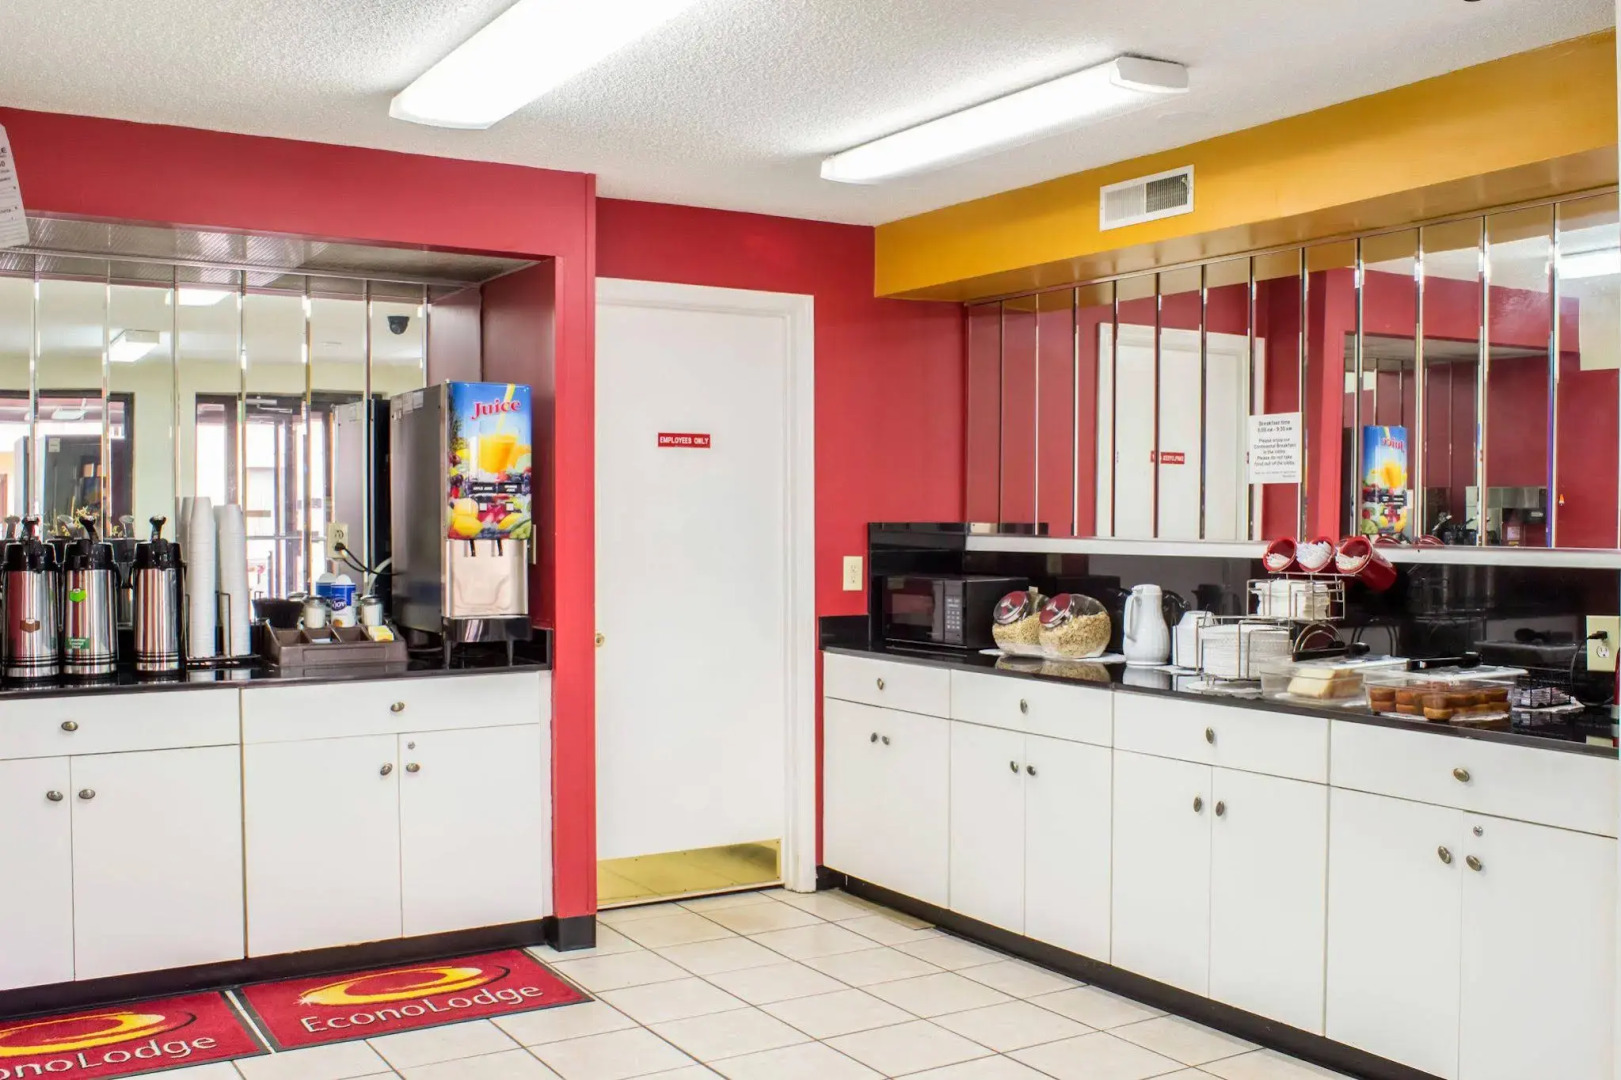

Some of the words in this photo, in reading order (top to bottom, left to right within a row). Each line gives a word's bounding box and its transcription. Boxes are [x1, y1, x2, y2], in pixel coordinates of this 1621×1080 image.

[471, 399, 521, 420] Juice
[660, 436, 692, 444] EMPLOYEES
[301, 986, 543, 1033] EconoLodge
